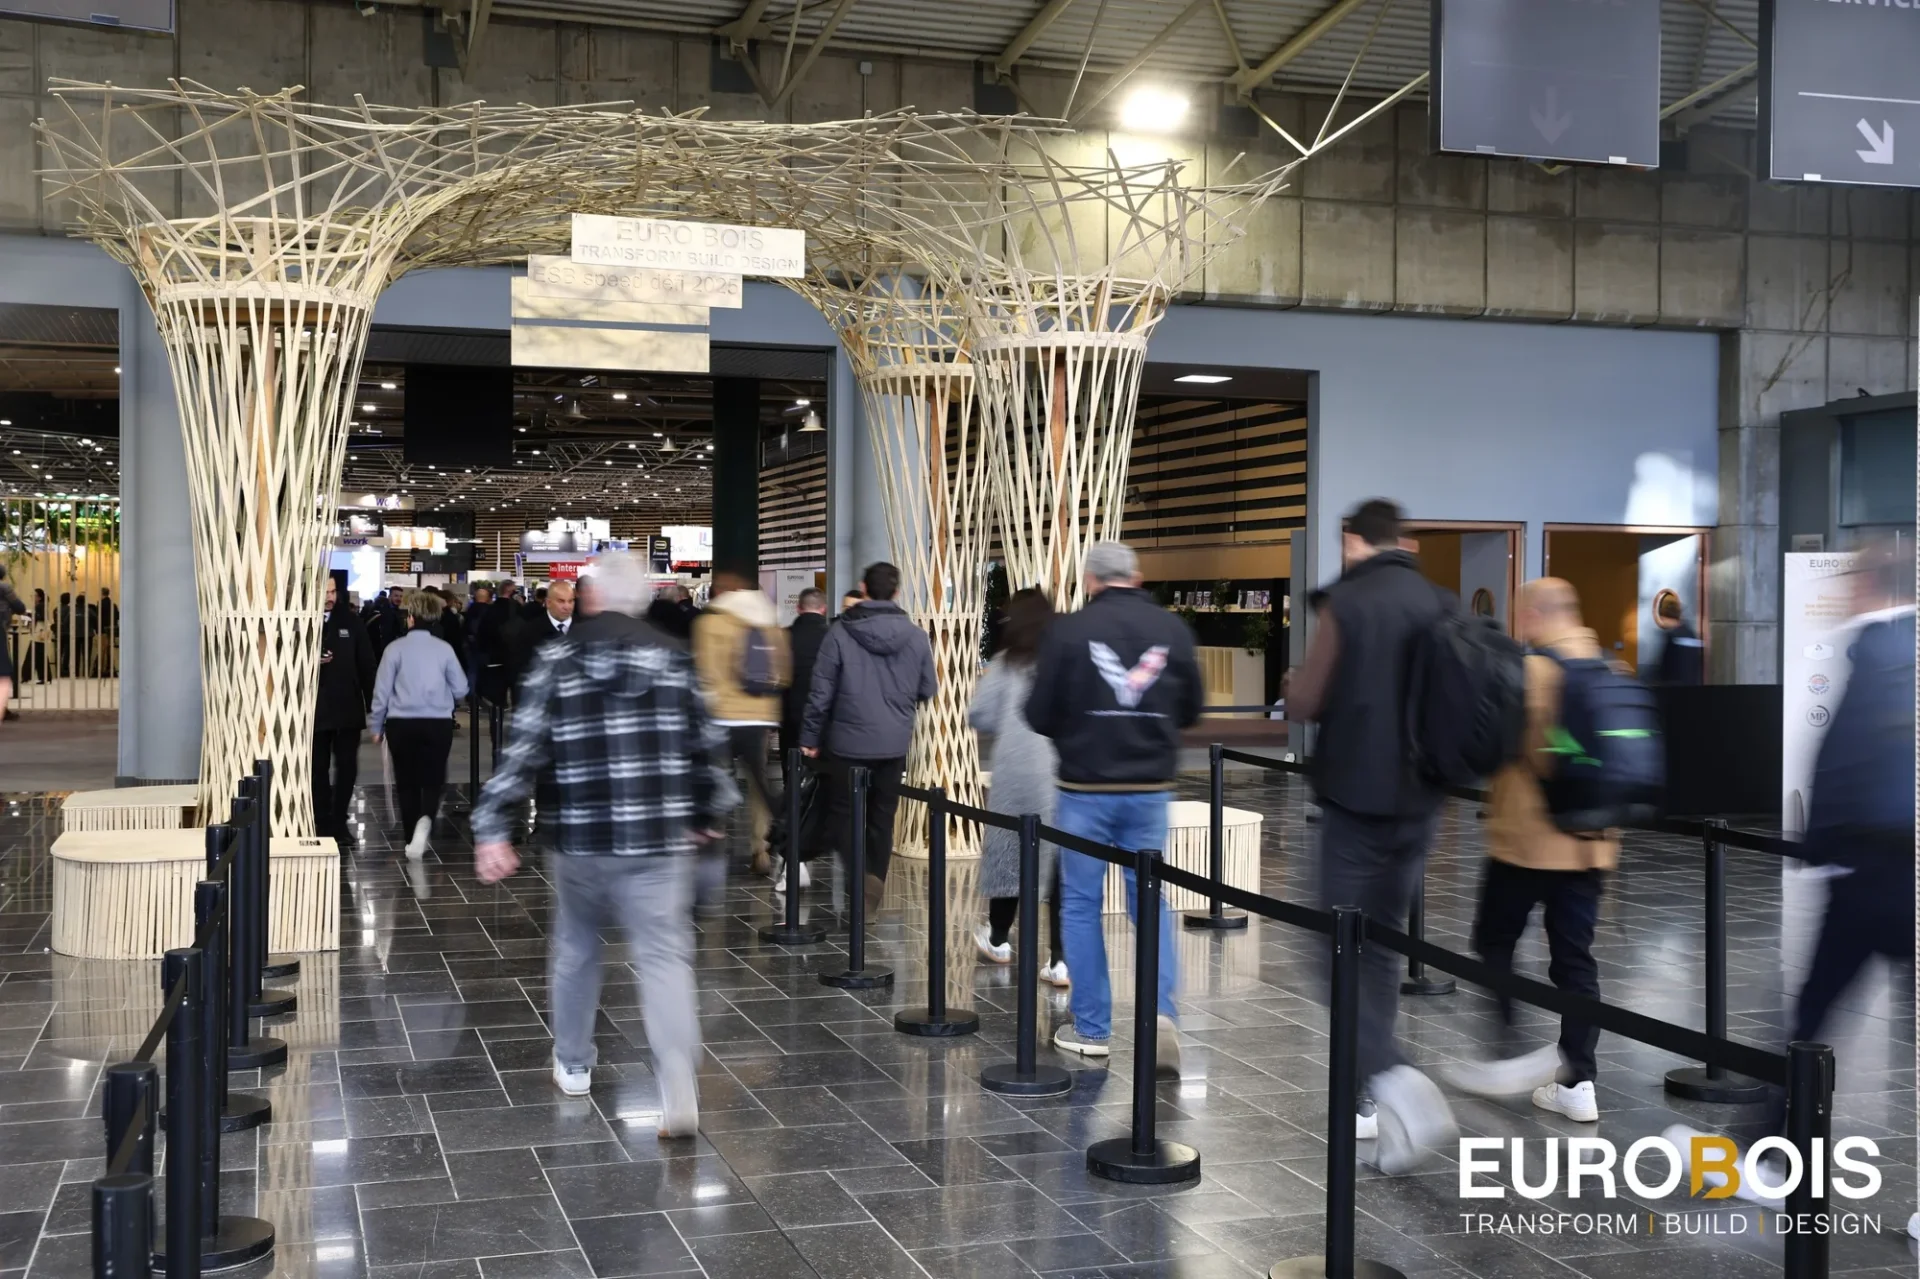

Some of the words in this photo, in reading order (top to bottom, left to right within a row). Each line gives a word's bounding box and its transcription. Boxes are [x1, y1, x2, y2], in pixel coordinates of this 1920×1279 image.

[616, 220, 693, 244] EURO
[703, 227, 764, 251] BOIS
[579, 244, 682, 263] TRANSFORM
[687, 252, 735, 268] BUILD
[741, 255, 799, 273] DESIGN
[533, 265, 575, 285] ESB
[691, 275, 739, 296] 2025
[343, 537, 369, 545] work
